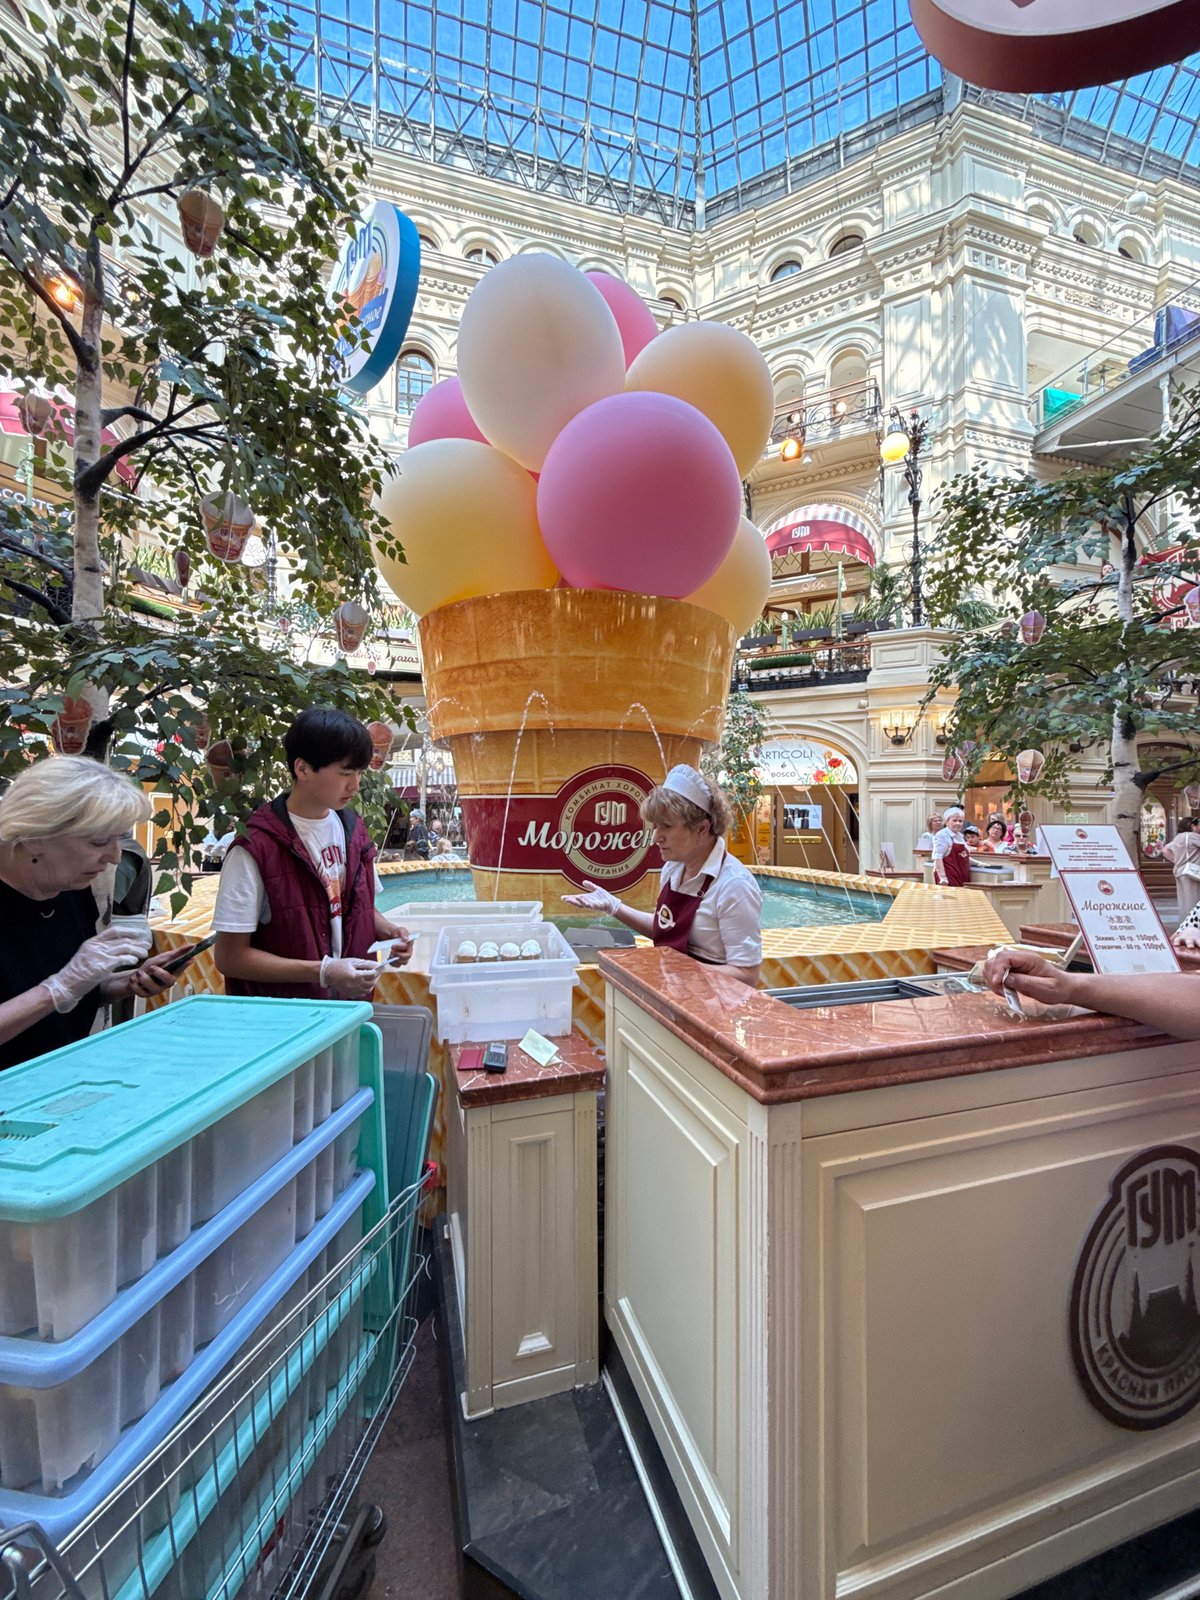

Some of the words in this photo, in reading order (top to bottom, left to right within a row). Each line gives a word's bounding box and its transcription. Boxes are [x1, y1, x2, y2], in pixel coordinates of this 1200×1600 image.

[792, 525, 811, 539] ГУМ
[565, 781, 611, 820] КОМБИНАТ
[594, 800, 627, 827] ГУМ
[587, 864, 630, 876] ПИТАНИЯ
[1081, 900, 1147, 916] Мороженое
[1127, 1167, 1197, 1249] ГУМ
[1097, 1342, 1159, 1399] КРАСНАЯ
